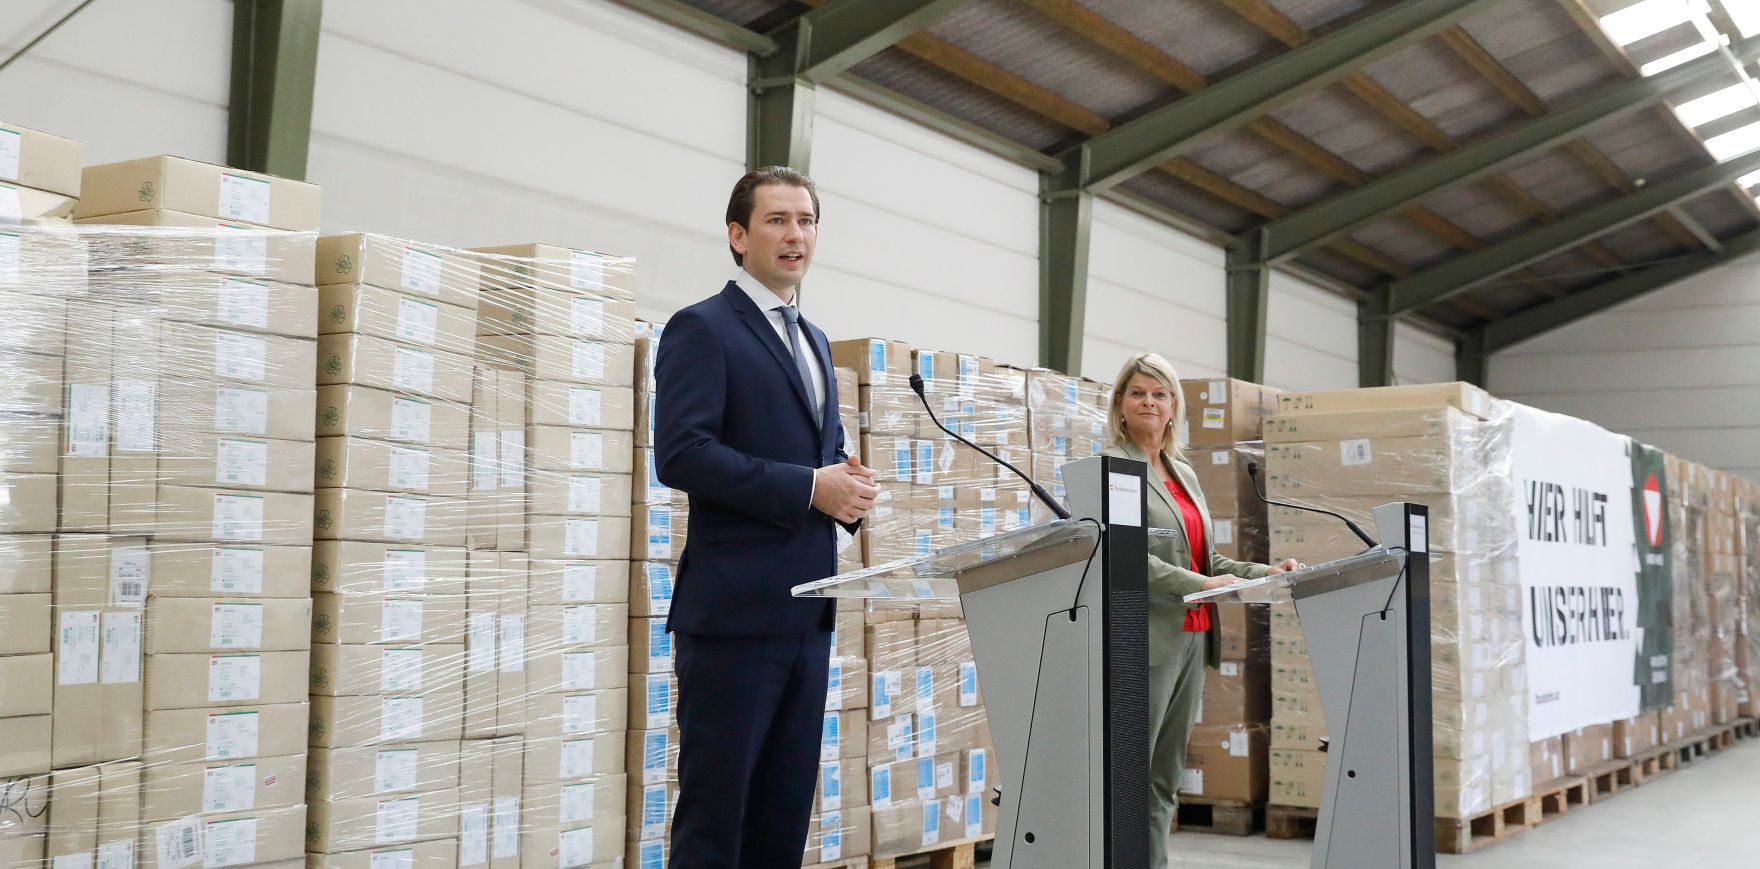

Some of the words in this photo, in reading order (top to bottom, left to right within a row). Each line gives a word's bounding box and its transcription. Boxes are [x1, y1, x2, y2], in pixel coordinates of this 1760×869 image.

[1523, 479, 1567, 543] HIER
[1572, 487, 1608, 547] HILFT
[1530, 586, 1586, 648] UNSER
